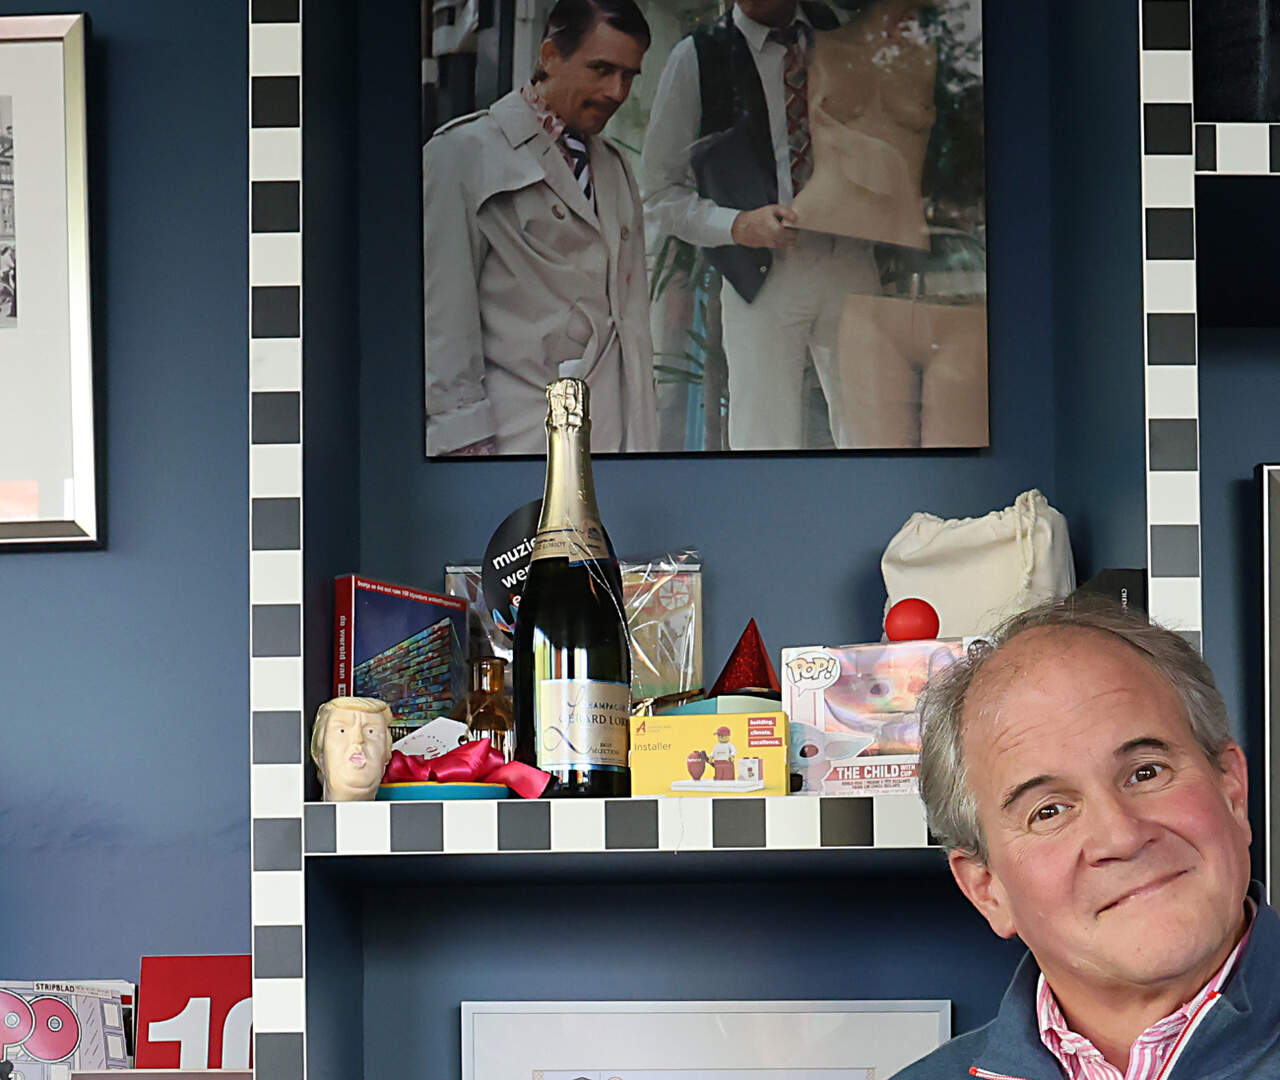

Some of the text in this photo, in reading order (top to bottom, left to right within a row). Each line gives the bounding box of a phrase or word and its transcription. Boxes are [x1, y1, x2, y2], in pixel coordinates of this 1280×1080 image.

[786, 656, 836, 683] POP!
[634, 742, 671, 752] Installer
[836, 766, 899, 779] THE CHILD
[35, 982, 76, 993] STRIPBLAD
